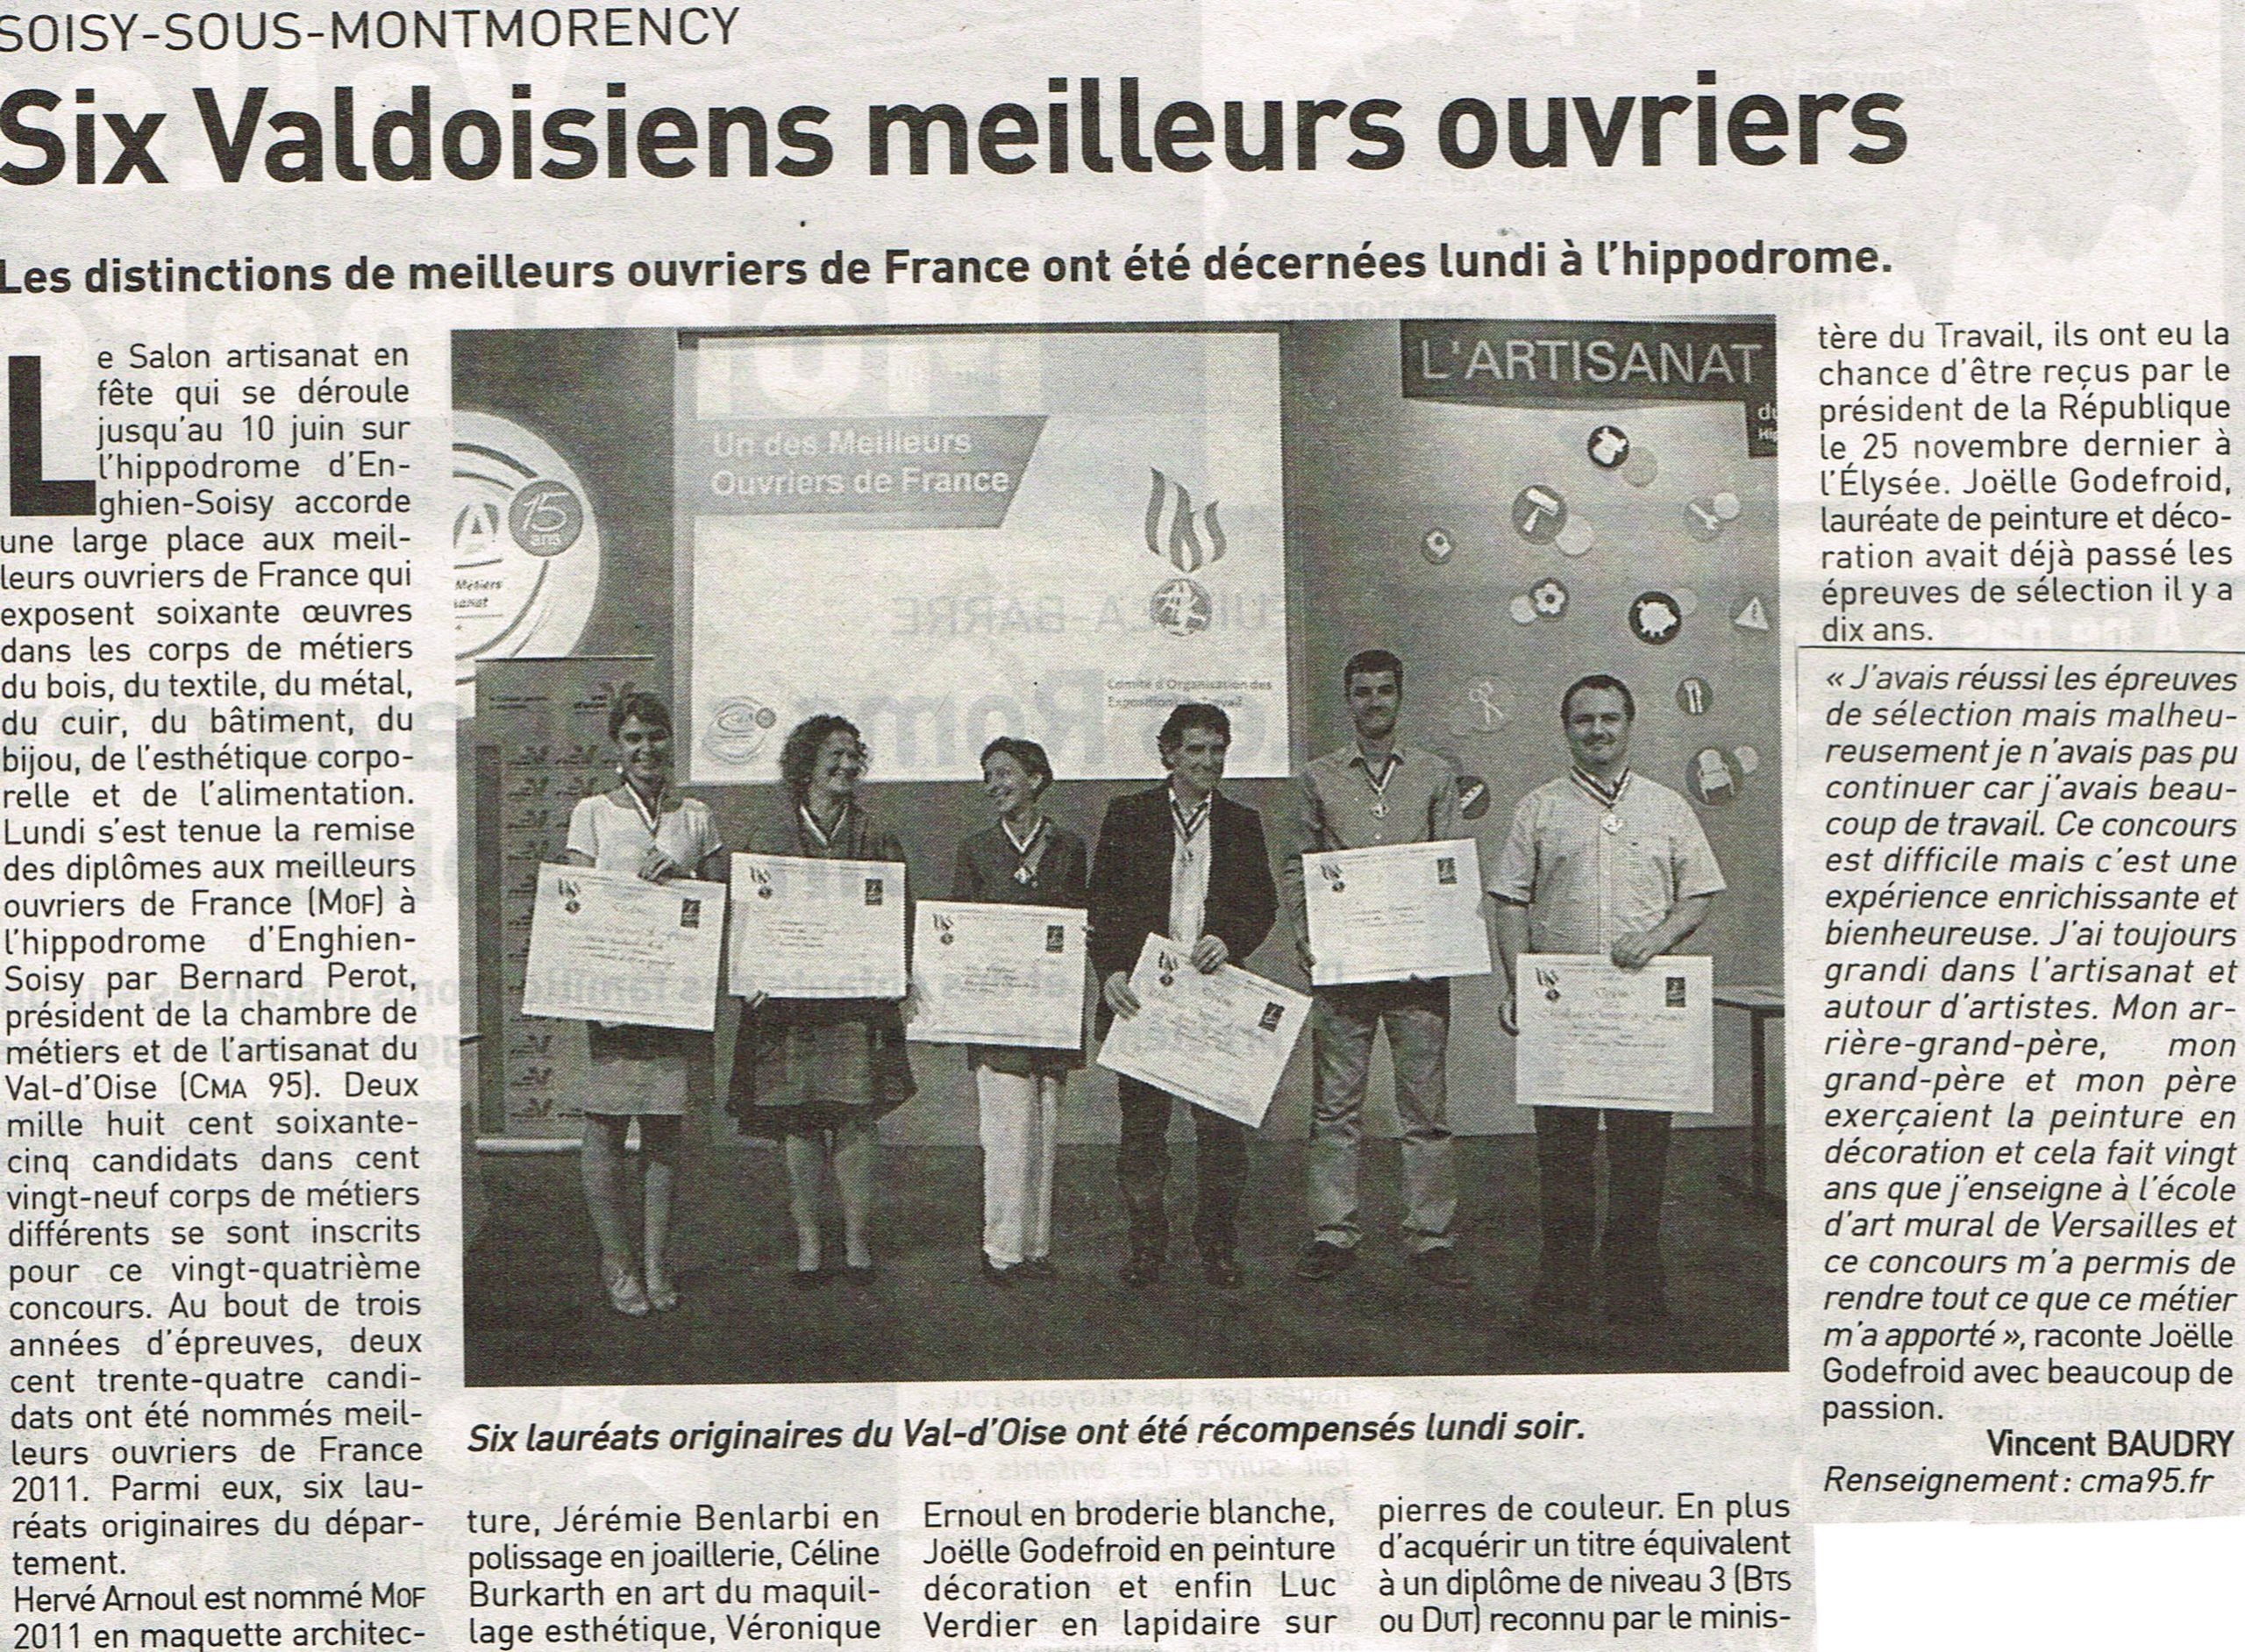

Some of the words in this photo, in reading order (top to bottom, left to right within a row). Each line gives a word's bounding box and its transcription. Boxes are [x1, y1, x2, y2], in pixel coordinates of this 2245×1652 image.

[0, 7, 739, 52] SOISY-SOUS-MONTMORENCY
[0, 89, 168, 185] Six
[193, 82, 832, 182] Valdoisiens
[870, 77, 1404, 175] meilleurs
[1439, 70, 1906, 168] ouvriers
[0, 260, 70, 294] Les
[86, 257, 331, 292] distinctions
[346, 256, 394, 289] de
[410, 254, 614, 288] meilleurs
[629, 252, 807, 286] ouvriers
[821, 250, 870, 284] de
[887, 249, 1029, 283] France
[1044, 250, 1110, 281] ont
[1125, 243, 1190, 281] été
[1205, 241, 1425, 280] décernées
[1441, 242, 1544, 277] lundi
[1561, 239, 1581, 275] à
[98, 352, 112, 368] e
[130, 343, 210, 368] Salon
[227, 342, 358, 367] artisanat
[375, 348, 407, 366] en
[1422, 339, 1762, 384] L'ARTISANAT
[98, 379, 153, 405] fête
[176, 379, 217, 412] qui
[243, 386, 274, 404] se
[299, 376, 408, 403] déroule
[1821, 395, 1962, 430] président
[1975, 395, 2008, 420] de
[2021, 395, 2045, 419] la
[2060, 393, 2229, 427] République
[243, 416, 273, 441] 10
[290, 415, 343, 448] juin
[363, 422, 410, 439] sur
[712, 431, 754, 457] Un
[763, 431, 818, 456] des
[829, 428, 973, 455] Meilleurs
[1821, 434, 1853, 460] le
[1864, 433, 1897, 459] 25
[1915, 431, 2067, 458] novembre
[2085, 430, 2200, 456] dernier
[2216, 428, 2229, 455] à
[330, 451, 410, 476] d'En-
[710, 469, 845, 496] Ouvriers
[852, 468, 891, 495] de
[901, 466, 1009, 493] France
[100, 489, 274, 521] ghien-Soisy
[296, 488, 410, 513] accorde
[523, 491, 572, 533] 15
[2, 602, 133, 633] exposent
[158, 601, 279, 624] soixante
[303, 604, 411, 623] œuvres
[1823, 616, 1863, 641] dix
[1874, 623, 1932, 641] ans.
[3, 710, 36, 735] du
[62, 709, 126, 737] cuir,
[153, 709, 185, 733] du
[212, 706, 353, 736] bâtiment,
[378, 706, 411, 731] du
[1827, 701, 1861, 725] de
[1872, 700, 2011, 726] sélection
[2023, 701, 2096, 726] mais
[2108, 702, 2236, 727] malheu-
[4, 856, 54, 880] des
[68, 853, 201, 887] diplômes
[214, 860, 264, 879] aux
[277, 851, 415, 878] meilleurs
[1827, 881, 1987, 915] expérience
[1999, 883, 2199, 909] enrichissante
[2211, 887, 2238, 909] et
[5, 965, 84, 998] Soisy
[108, 972, 157, 998] par
[182, 963, 302, 989] Bernard
[329, 962, 415, 991] Perot,
[7, 1000, 144, 1036] président
[157, 1000, 189, 1026] de
[203, 1000, 226, 1026] la
[241, 999, 370, 1025] chambre
[383, 999, 416, 1023] de
[1824, 1065, 2004, 1098] grand-père
[2027, 1069, 2056, 1091] et
[2077, 1074, 2143, 1092] mon
[2164, 1066, 2235, 1100] père
[8, 1148, 68, 1180] cinq
[94, 1146, 237, 1171] candidats
[262, 1145, 332, 1170] dans
[357, 1146, 419, 1169] cent
[11, 1264, 80, 1291] pour
[110, 1264, 141, 1281] ce
[172, 1252, 419, 1288] vingt-quatrième
[1824, 1357, 1963, 1383] Godefroid
[1975, 1365, 2038, 1383] avec
[2049, 1357, 2190, 1392] beaucoup
[2200, 1359, 2233, 1385] de
[12, 1440, 88, 1465] leurs
[112, 1438, 236, 1463] ouvriers
[261, 1437, 295, 1462] de
[321, 1436, 422, 1462] France
[467, 1424, 517, 1451] Six
[527, 1421, 659, 1451] lauréats
[670, 1421, 843, 1457] originaires
[853, 1420, 893, 1447] du
[1077, 1419, 1129, 1444] ont
[1138, 1414, 1187, 1443] été
[1198, 1412, 1415, 1449] récompensés
[1427, 1412, 1507, 1440] lundi
[1514, 1412, 1584, 1439] soir.
[1987, 1429, 2096, 1456] Vincent
[2109, 1430, 2234, 1456] BAUDRY
[13, 1476, 88, 1502] 2011.
[113, 1474, 198, 1500] Parmi
[223, 1481, 281, 1503] eux,
[304, 1472, 343, 1499] six
[367, 1472, 423, 1498] lau-
[1824, 1466, 2058, 1498] Renseignement
[2081, 1468, 2214, 1492] cma95.fr
[467, 1511, 538, 1536] ture,
[554, 1505, 681, 1532] Jérémie
[696, 1503, 827, 1530] Benlarbi
[844, 1510, 878, 1528] en
[1379, 1499, 1486, 1529] pierres
[1499, 1495, 1532, 1520] de
[1545, 1494, 1663, 1520] couleur.
[1678, 1492, 1712, 1519] En
[1727, 1492, 1789, 1526] plus
[13, 1551, 125, 1575] tement.
[923, 1538, 1009, 1563] Joëlle
[1020, 1535, 1159, 1563] Godefroid
[1170, 1543, 1202, 1561] en
[1215, 1535, 1335, 1568] peinture
[471, 1579, 603, 1606] Burkarth
[616, 1586, 650, 1605] en
[663, 1581, 704, 1605] art
[716, 1577, 750, 1604] du
[765, 1576, 880, 1610] maquil-
[923, 1611, 1037, 1637] Verdier
[1063, 1618, 1096, 1636] en
[1124, 1609, 1259, 1642] lapidaire
[1286, 1615, 1337, 1634] sur
